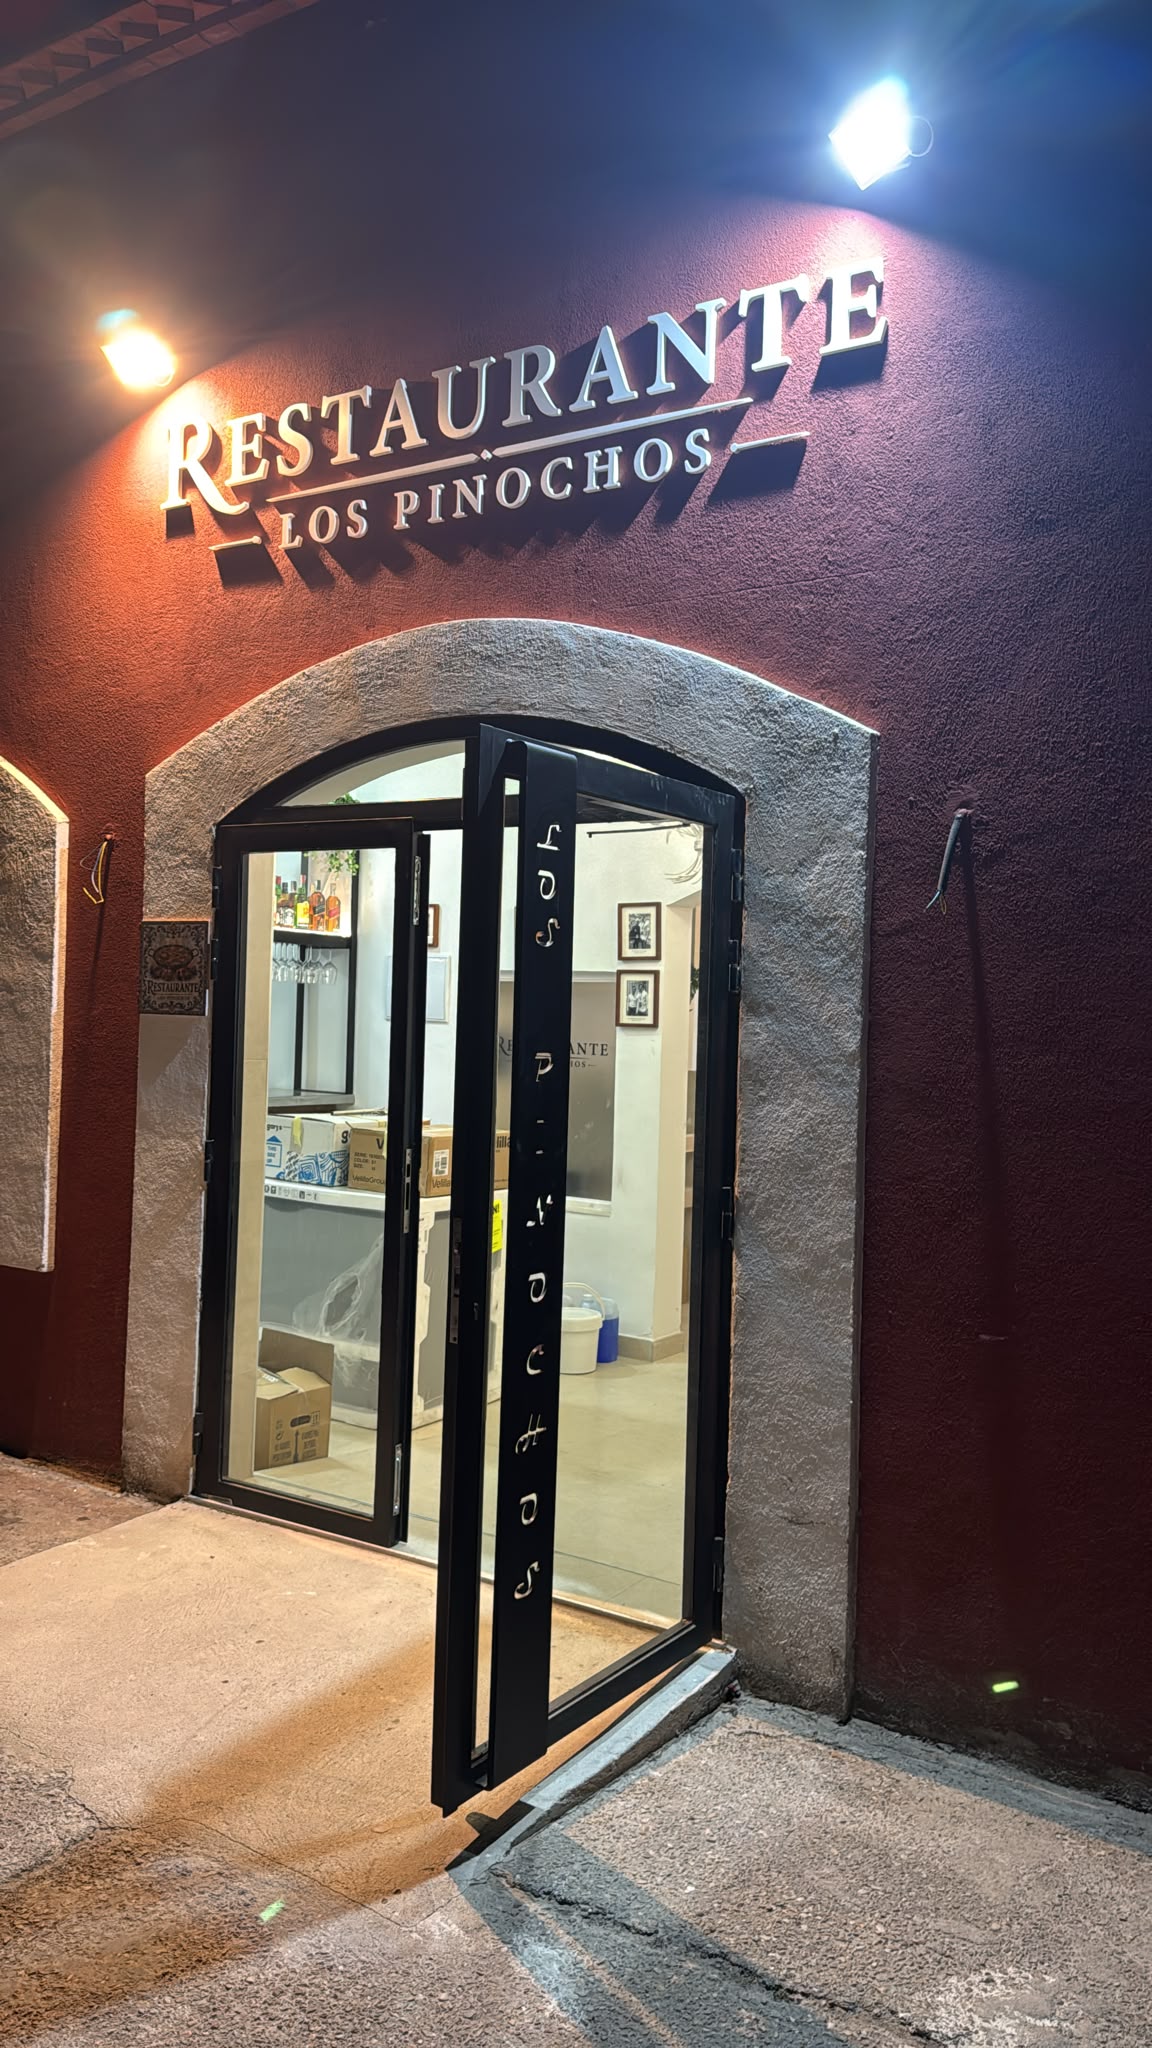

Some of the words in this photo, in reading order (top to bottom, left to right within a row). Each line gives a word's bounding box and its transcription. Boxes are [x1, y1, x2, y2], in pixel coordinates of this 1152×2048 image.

[160, 255, 890, 516] RESTAURANTE
[279, 498, 371, 551] LOS
[392, 427, 713, 532] PINOCHOS
[535, 824, 562, 948] LOS
[147, 980, 199, 995] RESTAURANTE
